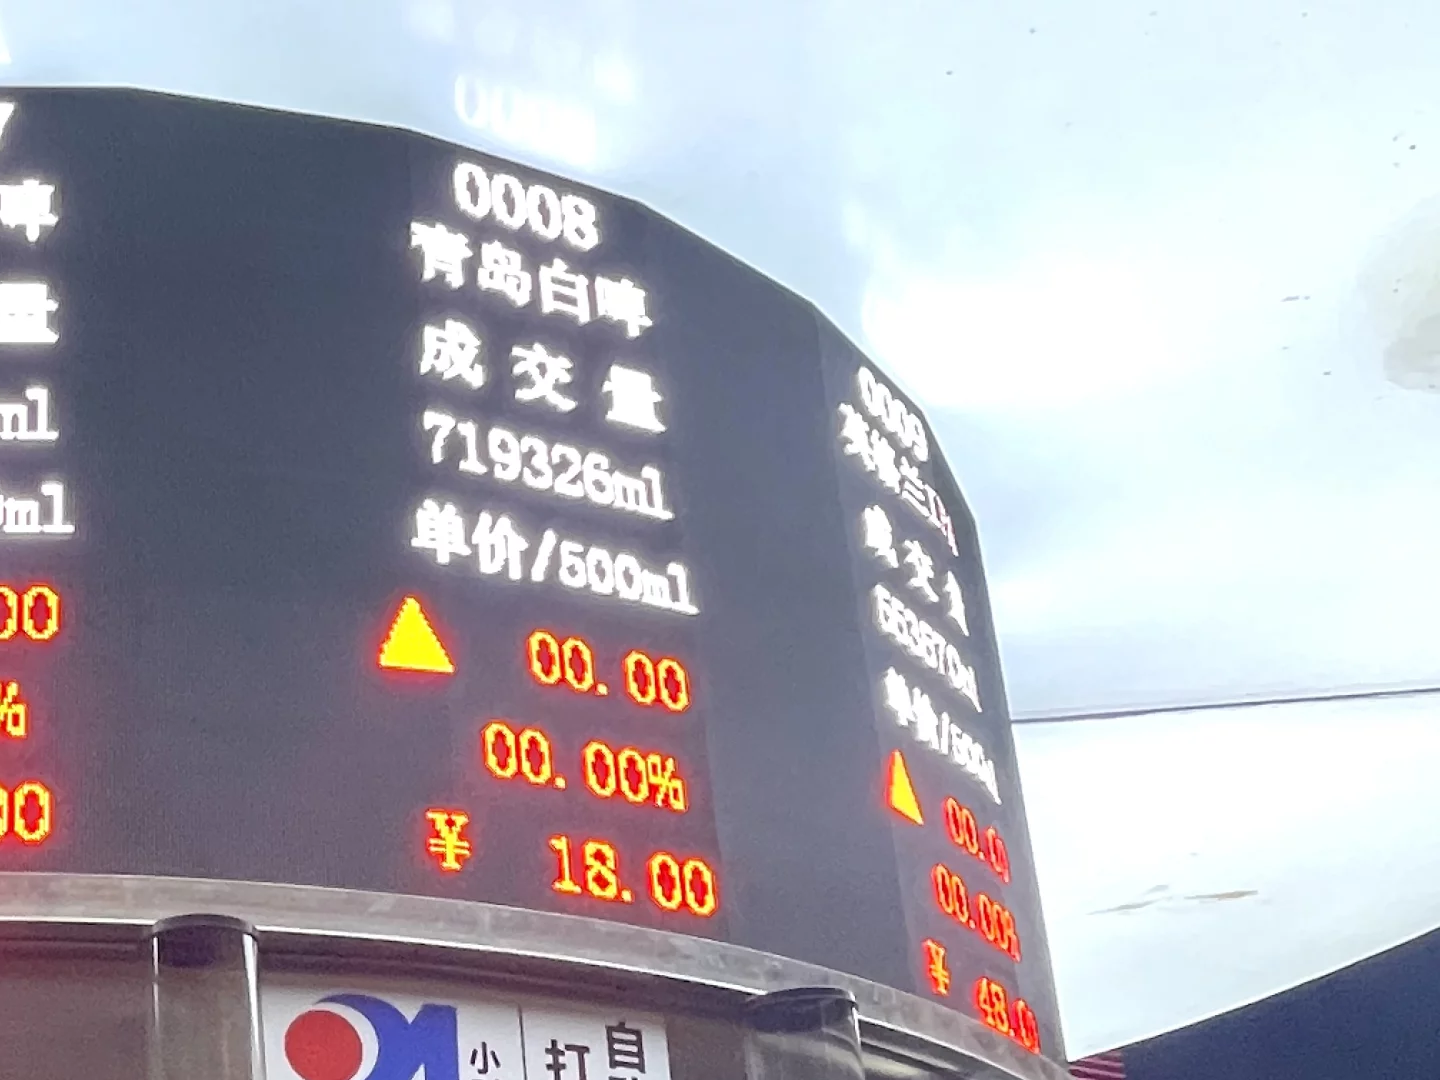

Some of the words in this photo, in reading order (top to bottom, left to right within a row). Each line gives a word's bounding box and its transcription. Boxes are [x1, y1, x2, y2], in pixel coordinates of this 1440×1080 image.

[453, 162, 599, 252] 0008
[409, 221, 653, 339] 青岛白啤
[419, 319, 667, 434] 成交量
[858, 366, 928, 462] 0009
[423, 409, 674, 522] 719326ml
[410, 499, 700, 616] 单价/500ml
[527, 631, 690, 712] 00.00
[481, 720, 687, 812] 00.00%
[549, 834, 718, 916] 18.00
